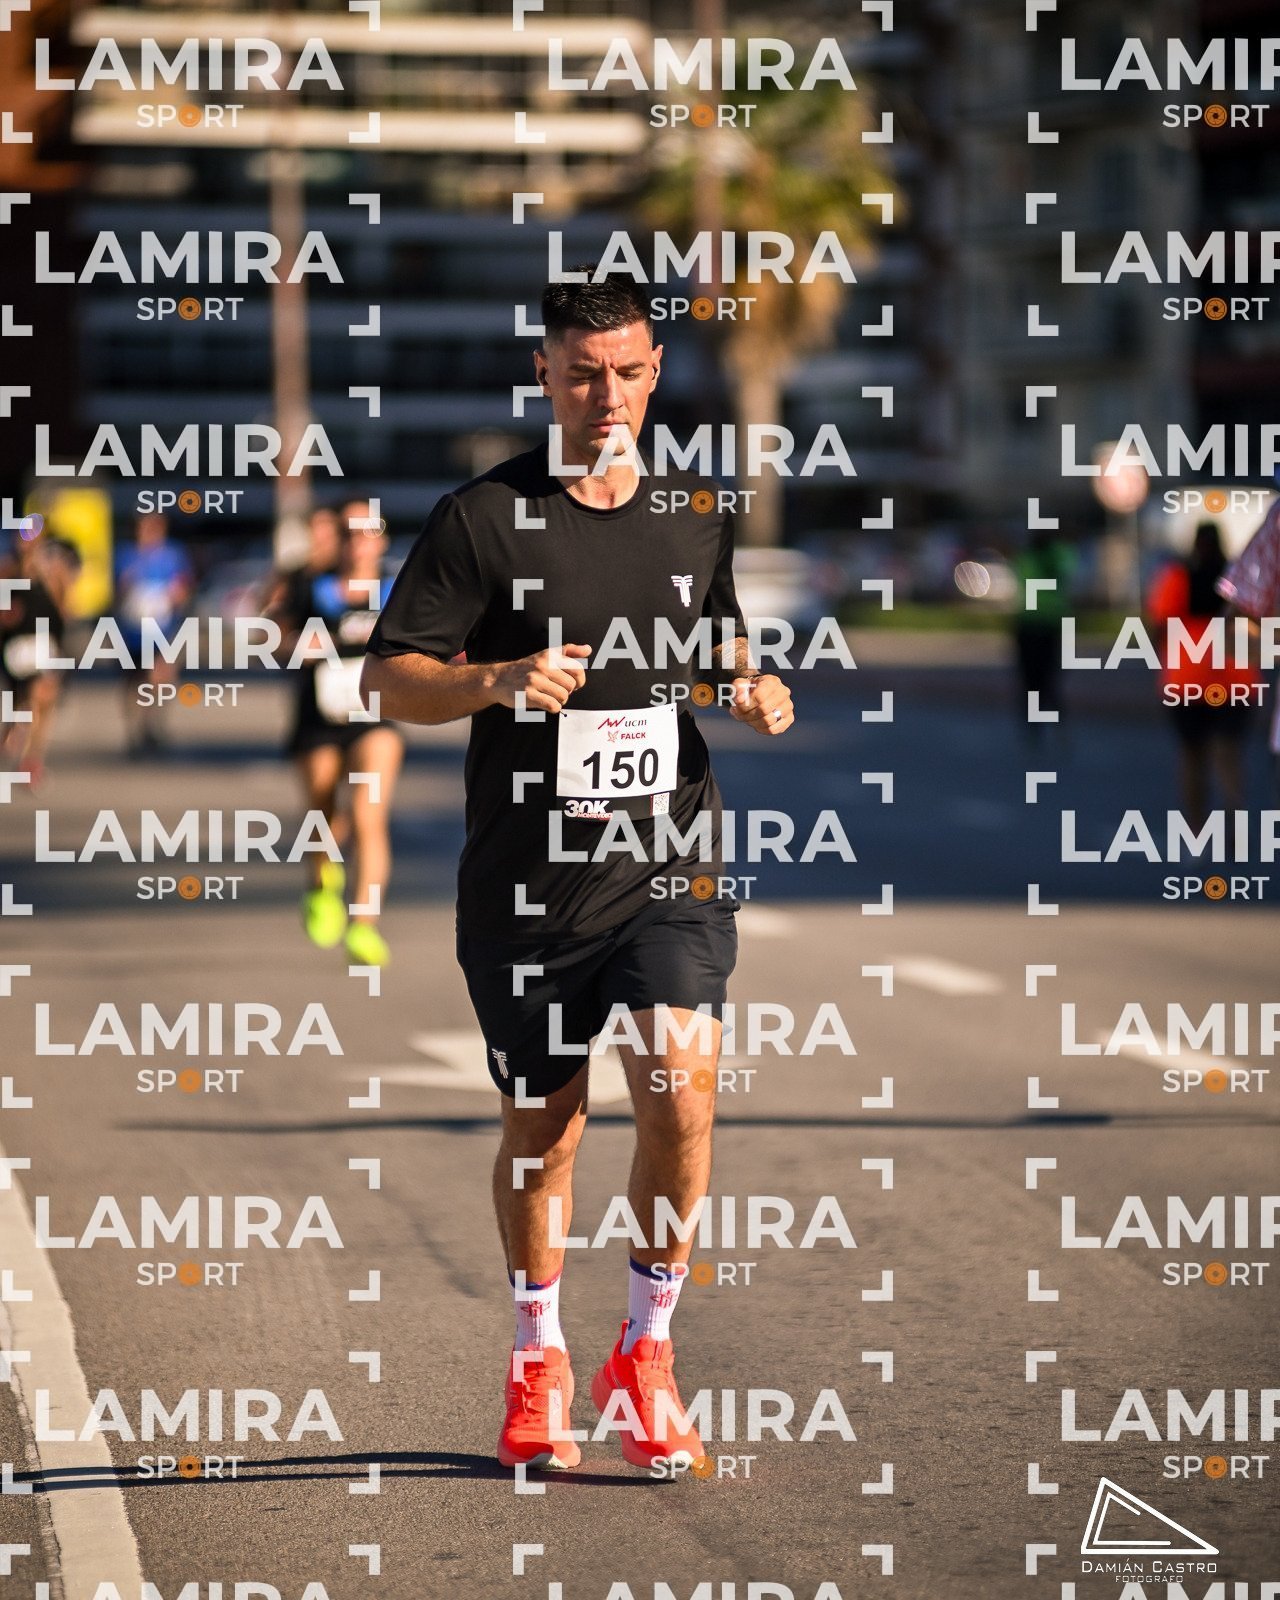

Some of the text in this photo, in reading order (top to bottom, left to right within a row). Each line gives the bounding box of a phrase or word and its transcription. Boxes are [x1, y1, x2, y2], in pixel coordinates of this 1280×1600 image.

[620, 732, 646, 740] FALCK
[583, 748, 659, 790] 150
[563, 799, 610, 818] 30K
